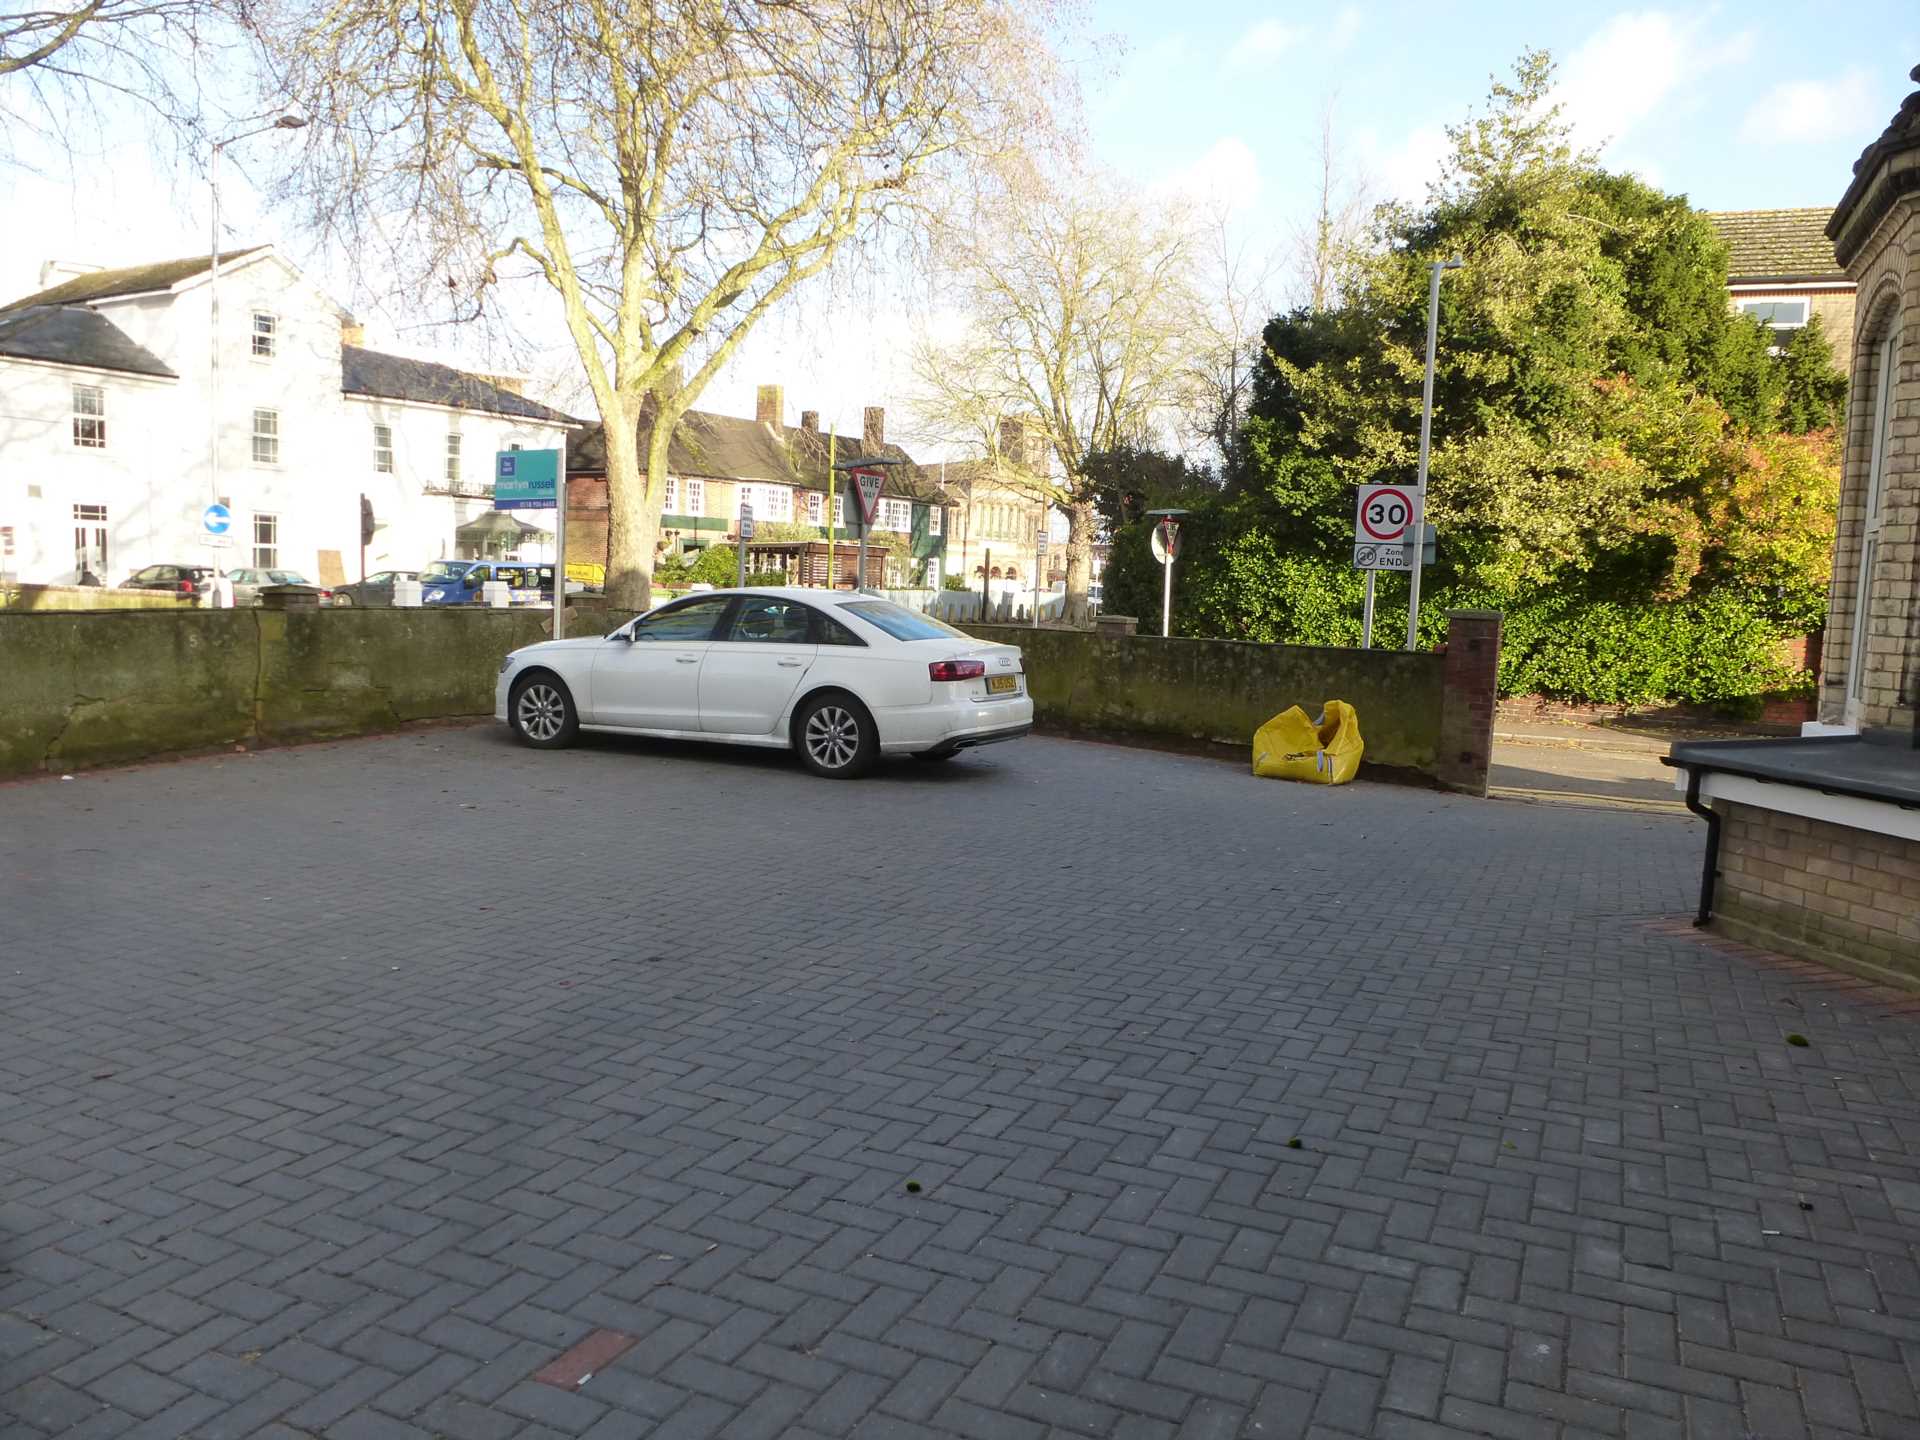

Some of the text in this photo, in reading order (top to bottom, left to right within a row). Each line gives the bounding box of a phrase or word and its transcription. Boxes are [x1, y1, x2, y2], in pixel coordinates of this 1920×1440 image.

[860, 476, 880, 488] GIVE
[1368, 504, 1405, 525] 30
[1359, 551, 1374, 561] 20
